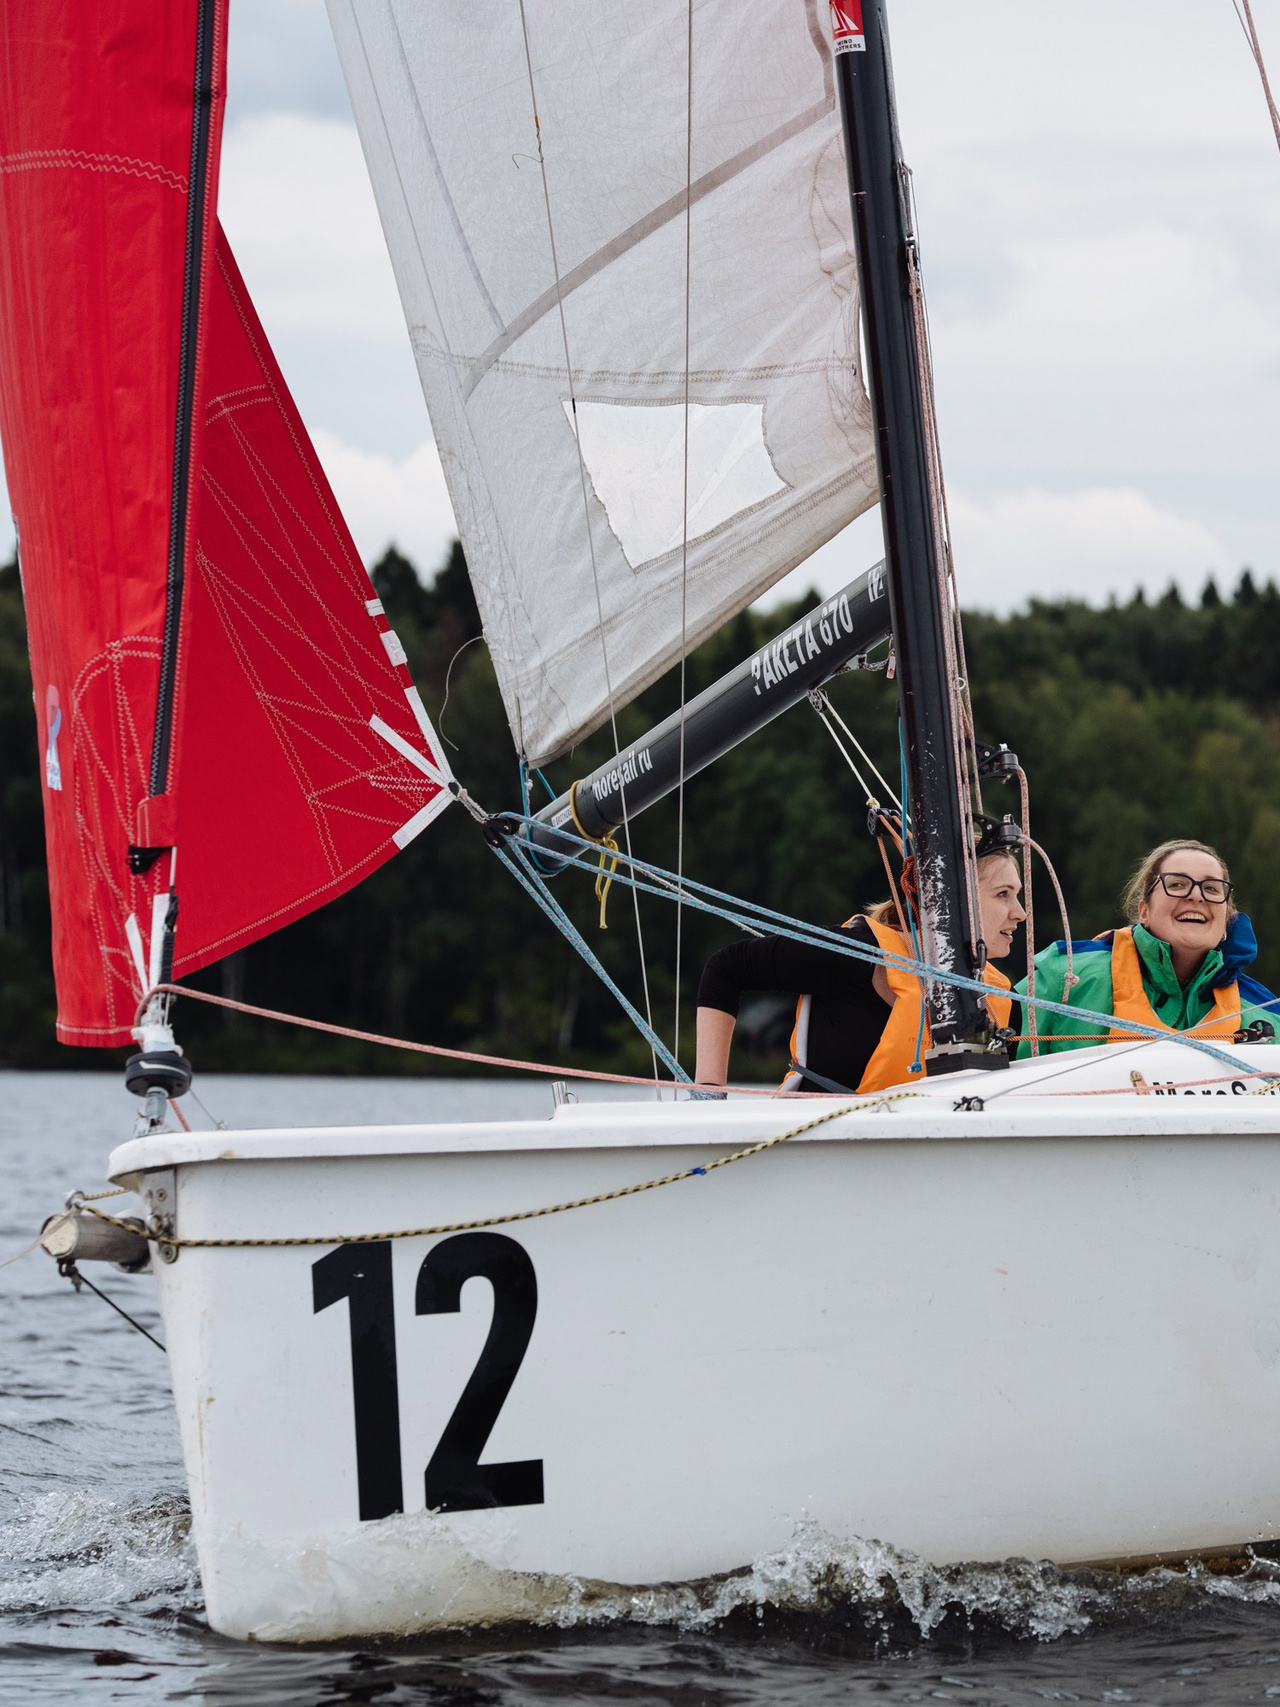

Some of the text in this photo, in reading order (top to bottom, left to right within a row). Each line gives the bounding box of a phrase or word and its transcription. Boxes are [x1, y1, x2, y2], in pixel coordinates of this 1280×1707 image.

[837, 38, 853, 46] WIND
[819, 593, 854, 646] 670
[311, 1231, 545, 1522] 12
